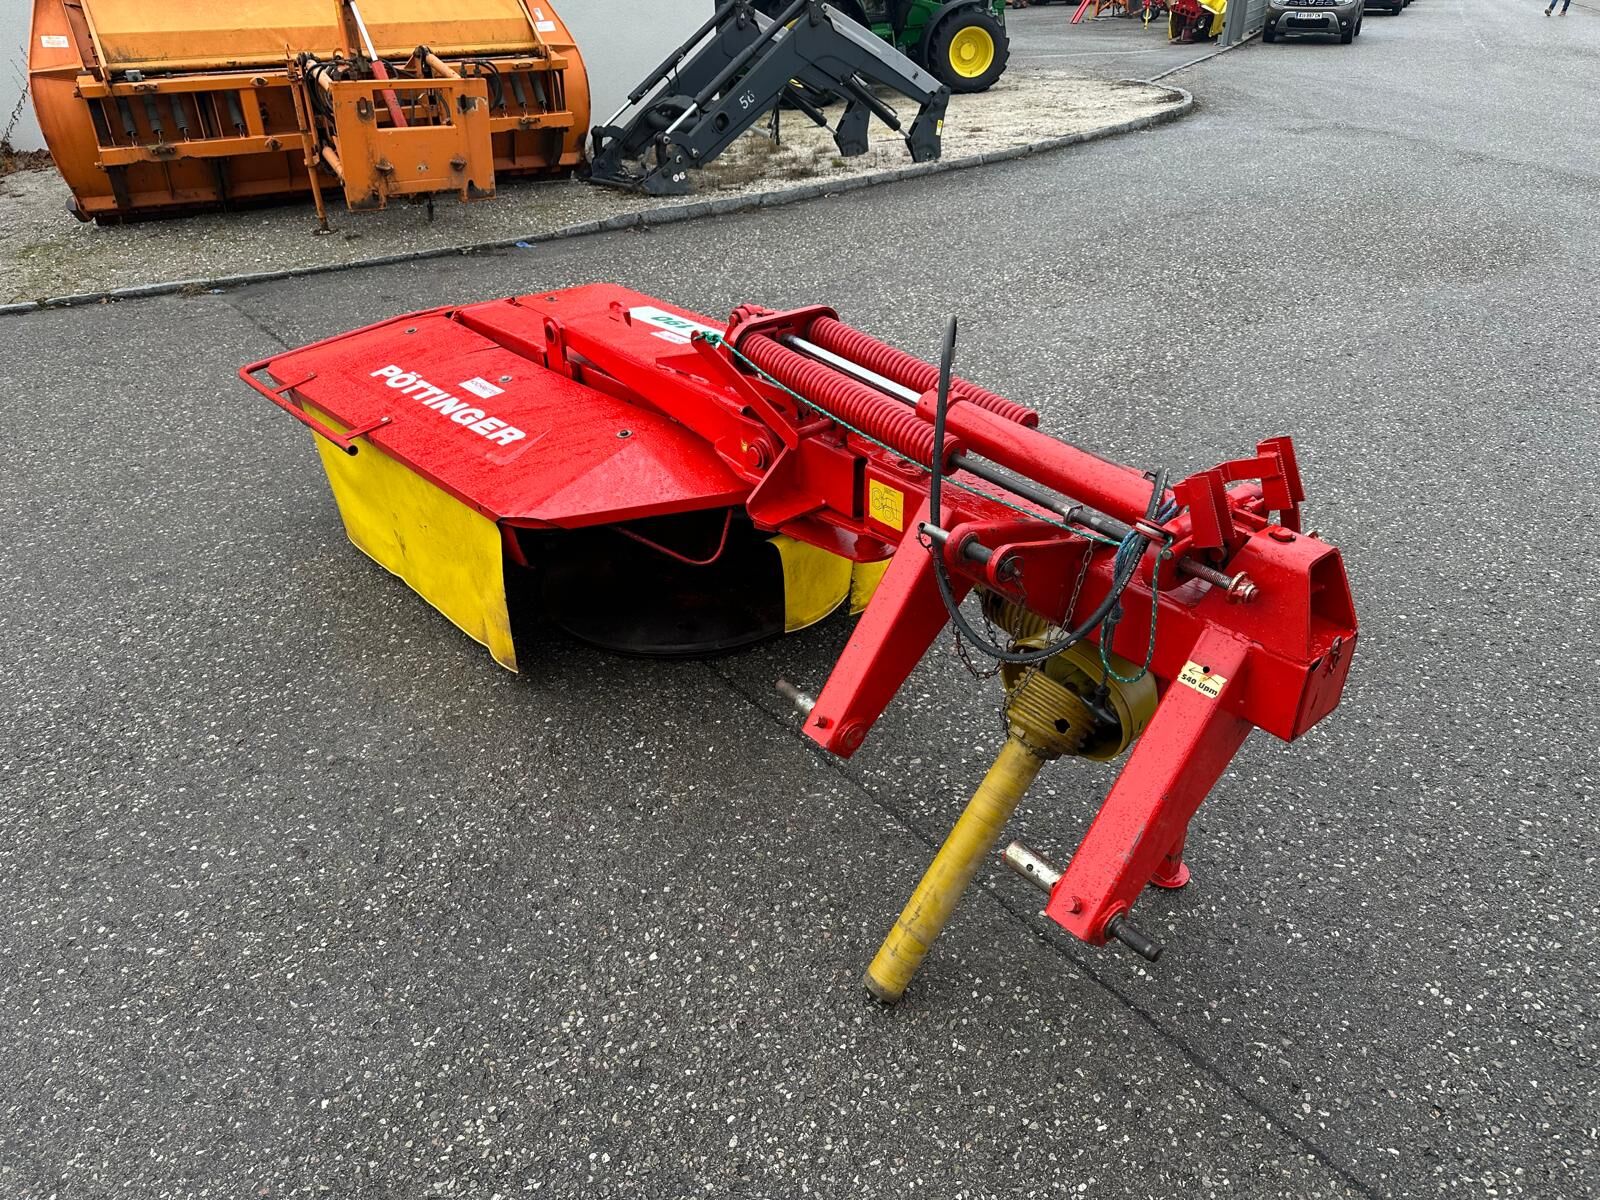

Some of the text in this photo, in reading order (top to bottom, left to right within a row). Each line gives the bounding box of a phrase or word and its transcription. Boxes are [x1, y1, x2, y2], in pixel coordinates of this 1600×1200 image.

[651, 316, 694, 329] 190
[369, 364, 527, 446] PÖTTINGER
[1181, 673, 1218, 696] 540 Upm
